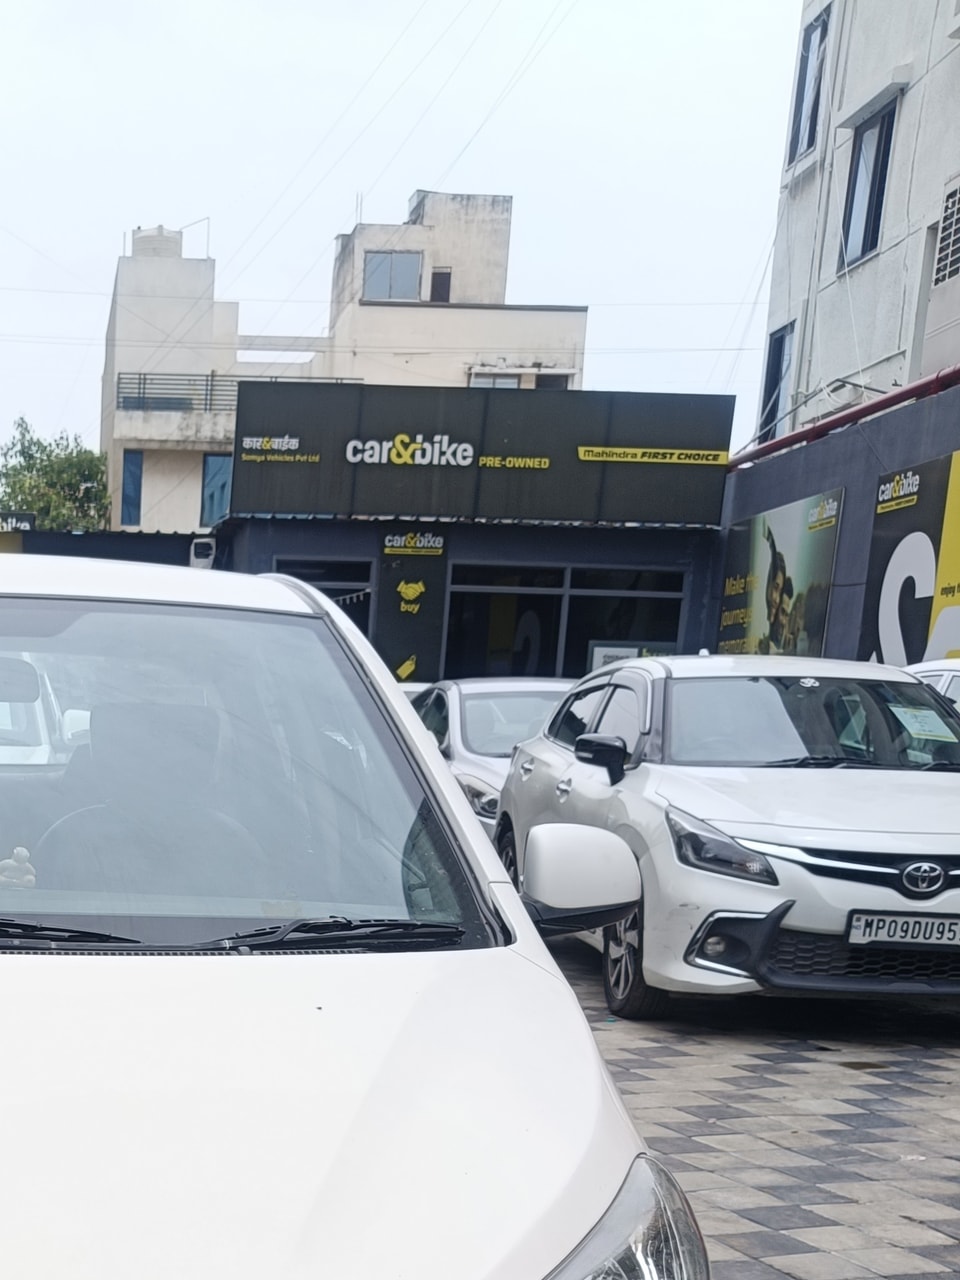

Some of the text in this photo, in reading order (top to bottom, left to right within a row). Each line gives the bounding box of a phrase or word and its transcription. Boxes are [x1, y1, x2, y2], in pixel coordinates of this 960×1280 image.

[346, 433, 550, 469] car&bike PRE-OWNED
[583, 449, 721, 462] Mahindra FIRST CHOICE
[878, 470, 920, 502] car&bike
[384, 532, 444, 548] car&bike
[400, 601, 420, 614] buy
[862, 917, 960, 941] MP09DU95
